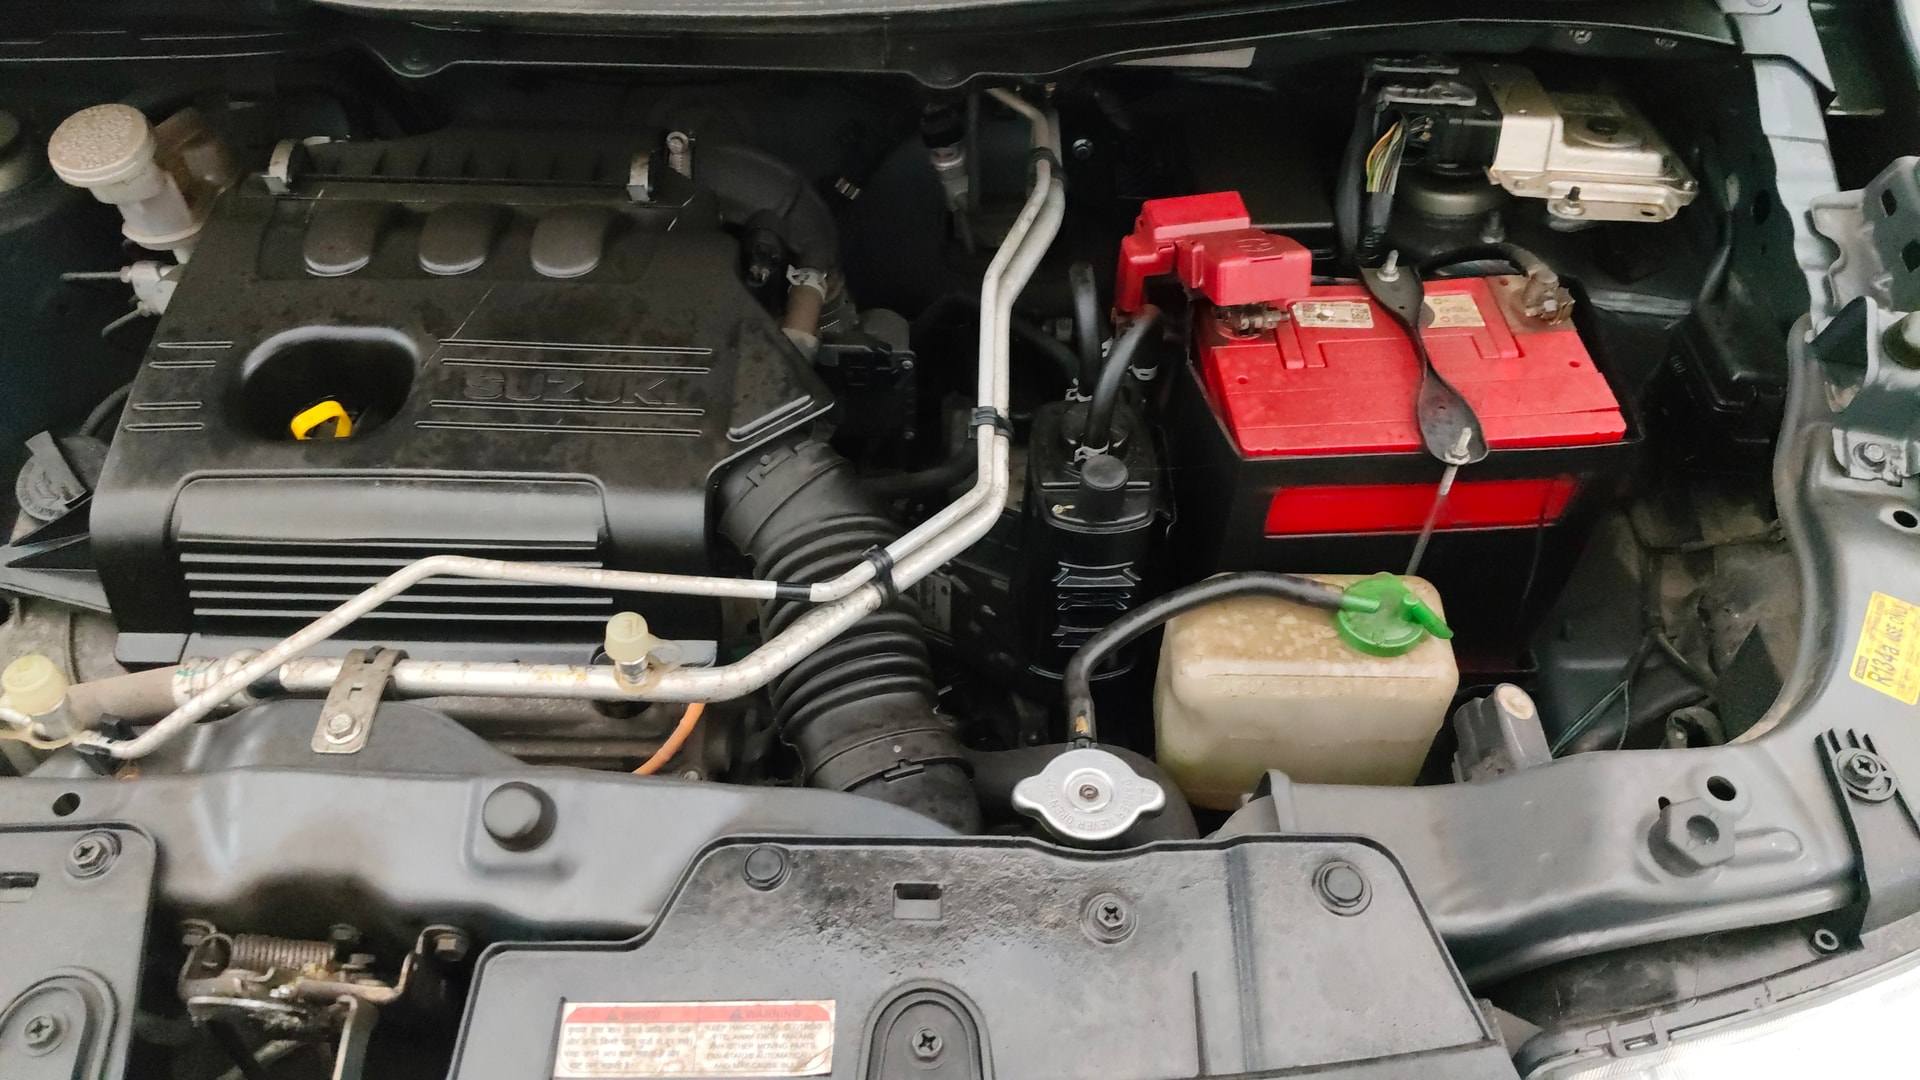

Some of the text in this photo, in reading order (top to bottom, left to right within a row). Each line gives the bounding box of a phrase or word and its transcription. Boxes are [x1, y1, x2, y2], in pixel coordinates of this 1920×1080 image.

[1889, 602, 1908, 625] ONLY
[1885, 623, 1904, 642] USE
[1867, 644, 1901, 687] R134a
[745, 1008, 801, 1019] WARNING
